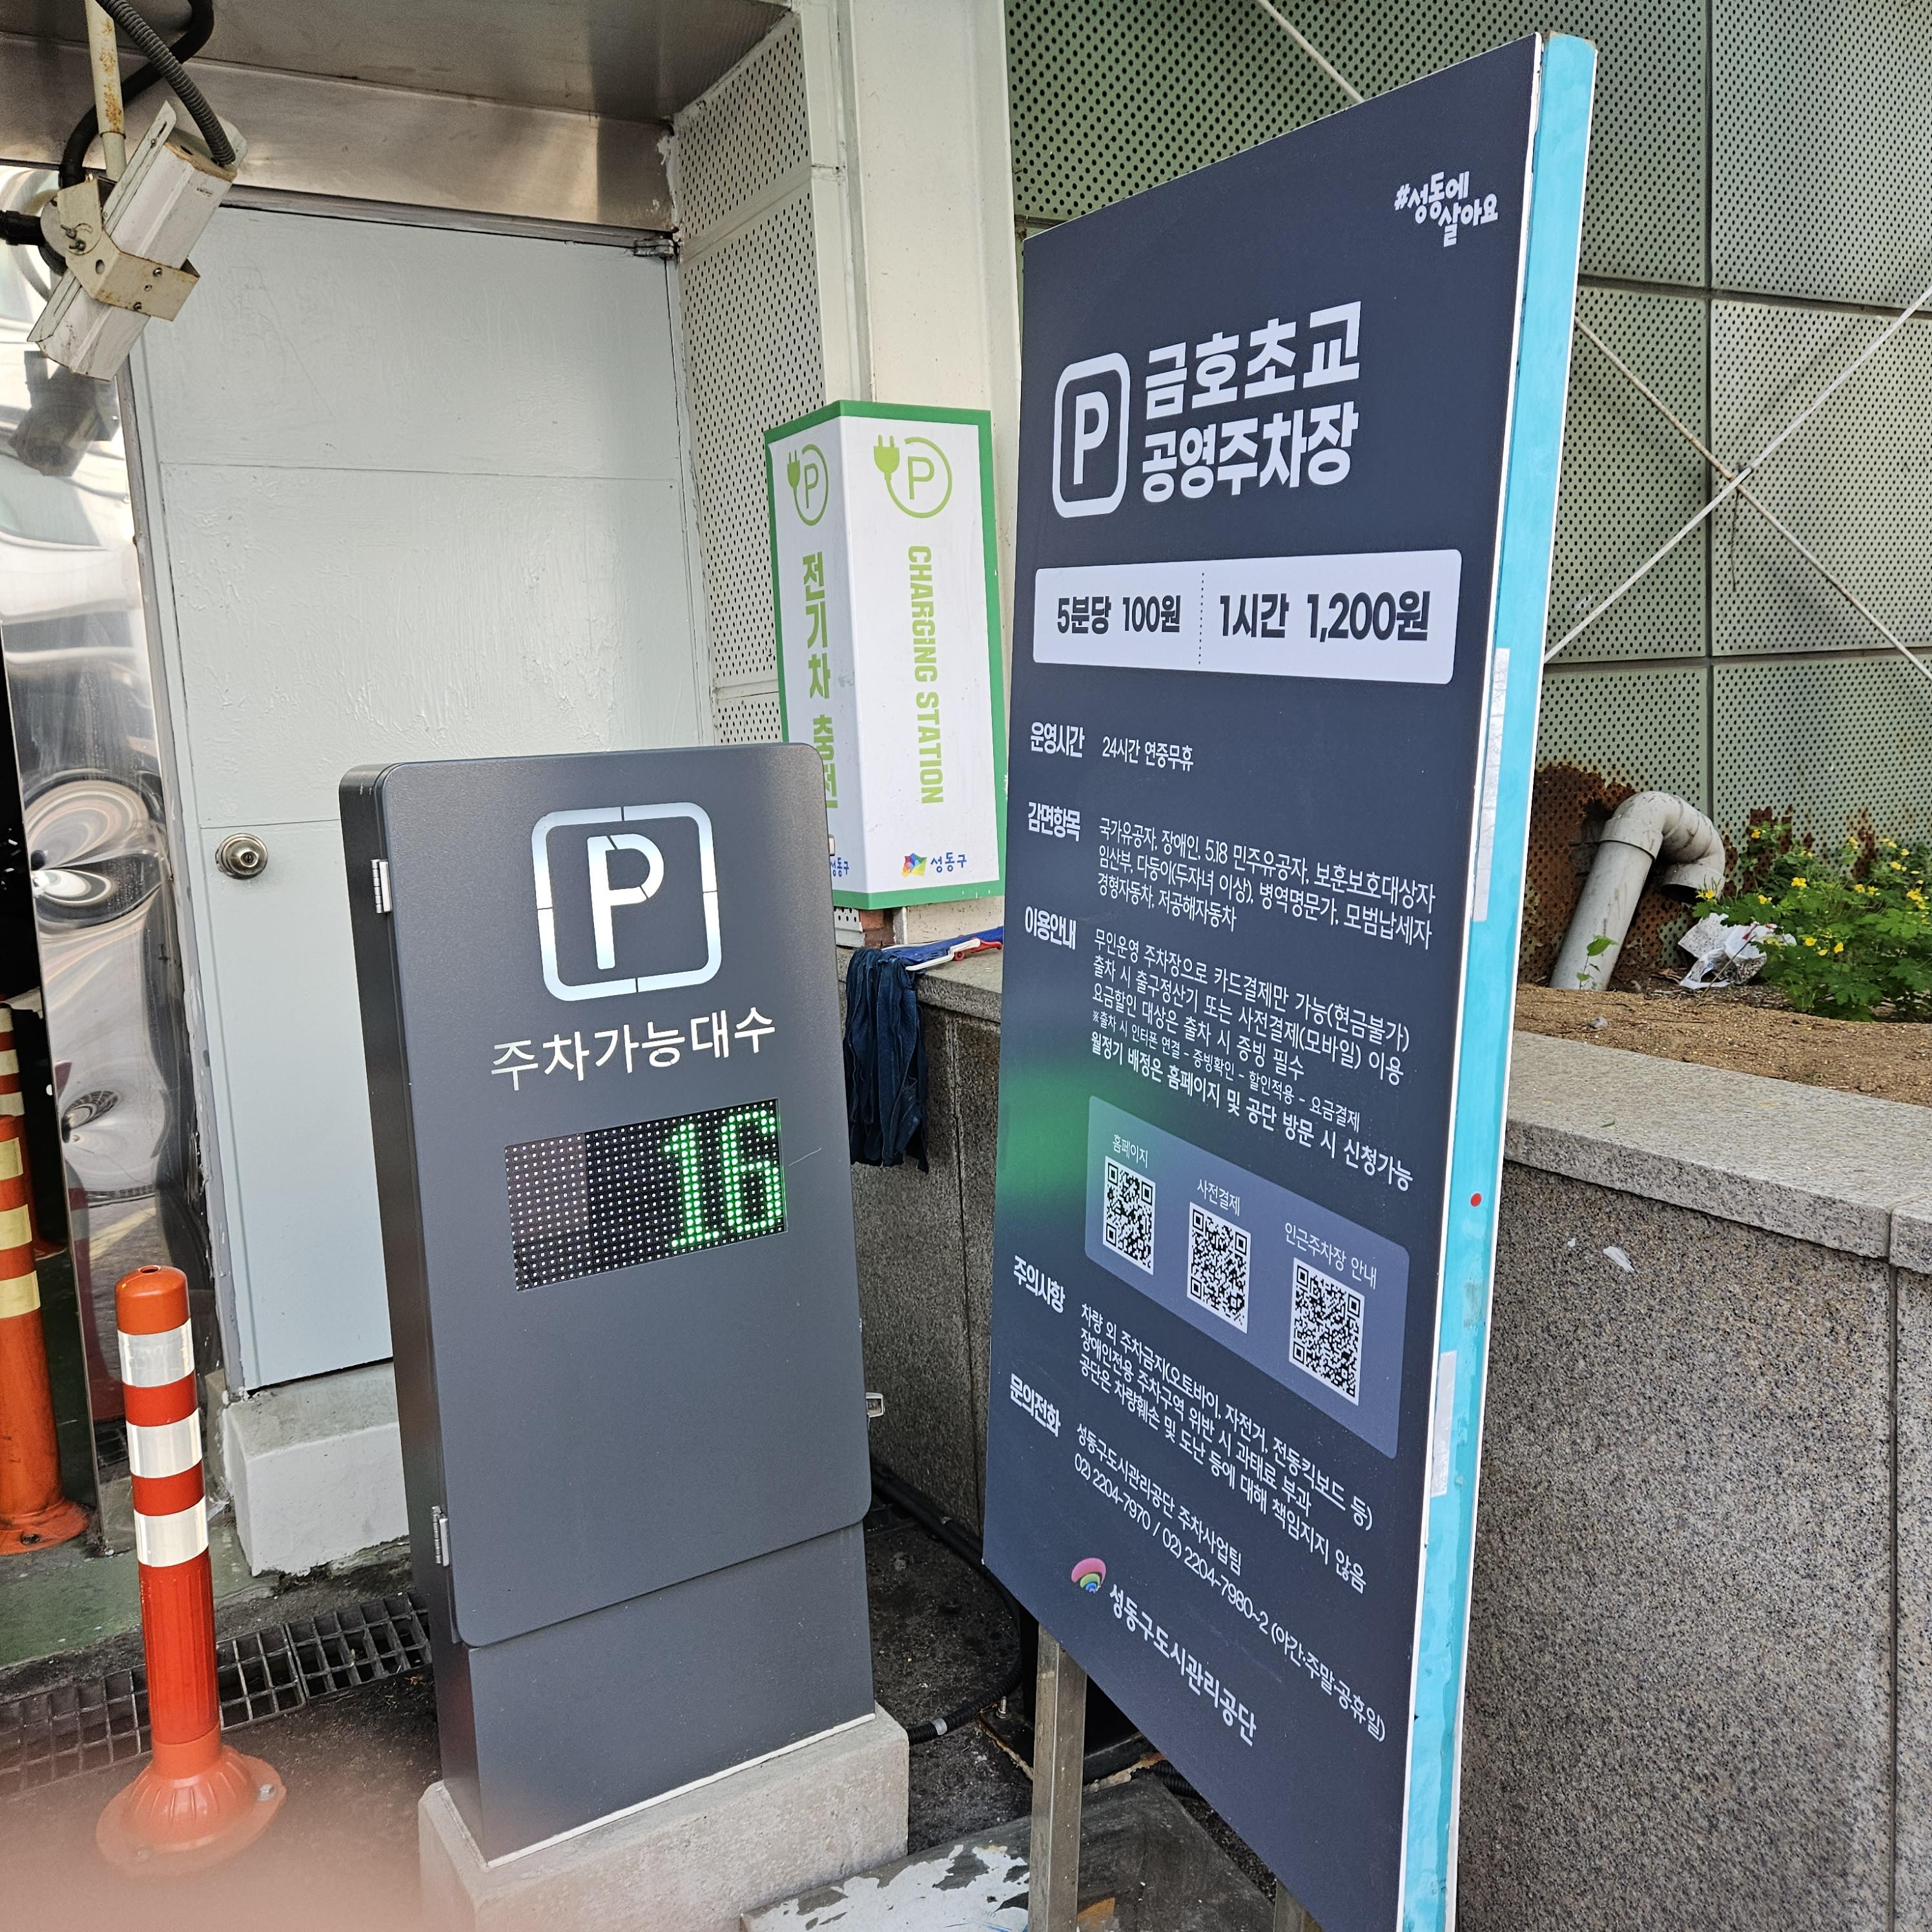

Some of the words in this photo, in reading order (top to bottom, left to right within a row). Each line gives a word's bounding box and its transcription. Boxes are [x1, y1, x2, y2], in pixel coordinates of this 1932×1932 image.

[1394, 171, 1470, 224] #성동에
[1438, 194, 1498, 247] 살아요
[1145, 301, 1361, 420] 금호초교
[805, 463, 819, 509] P
[908, 456, 935, 500] P
[1074, 391, 1109, 484] P
[1142, 402, 1359, 503] 공영주차장
[803, 551, 831, 699] 전기차
[908, 546, 938, 682] CHARGING
[1058, 595, 1111, 635] 5분당
[1122, 595, 1181, 633] 100원
[1220, 593, 1289, 638] 1시간
[1307, 590, 1430, 642] 1,200원
[916, 692, 944, 803] STATION
[1031, 722, 1085, 758] 운영시간
[1102, 736, 1141, 763] 24시간
[1145, 741, 1193, 772] 연중무휴
[930, 852, 967, 873] 성동구
[1028, 801, 1080, 842] 감면항목
[1099, 817, 1157, 851] 국가유공자,
[1162, 830, 1200, 860] 장애인,
[1205, 839, 1228, 864] 5.18
[1233, 845, 1310, 885] 민주유공자,
[1314, 862, 1436, 914] 보훈보호대상자
[586, 833, 664, 970] P
[1025, 906, 1076, 950] 이용안내
[1098, 872, 1155, 909] 경형자동차,
[1158, 889, 1237, 932] 저공해자동차
[1099, 845, 1133, 874] 임산부,
[1137, 855, 1214, 896] 다둥이(두자녀
[1219, 874, 1254, 904] 이상),
[1260, 882, 1339, 926] 병역명문가,
[1344, 903, 1432, 951] 모범납세자
[1093, 983, 1136, 1018] 요금할인
[1142, 1001, 1178, 1034] 대상은
[1184, 1016, 1211, 1047] 출차
[1217, 1030, 1230, 1055] 시
[1237, 1035, 1266, 1068] 증빙
[1273, 1048, 1304, 1081] 필수
[1094, 929, 1139, 963] 무인운영
[1144, 945, 1208, 984] 주차장으로
[1215, 967, 1289, 1012] 카드결제만
[1295, 992, 1410, 1052] 가능(현금불가)
[1094, 955, 1116, 982] 출차
[1120, 965, 1131, 989] 시
[1136, 970, 1198, 1013] 출구정산기
[1204, 995, 1233, 1024] 또는
[1238, 1006, 1361, 1069] 사전결제(모바일)
[1369, 1051, 1404, 1085] 이용
[490, 1006, 776, 1091] 주차가능대수
[1120, 1020, 1127, 1038] 시
[1131, 1024, 1158, 1050] 인터폰
[1162, 1036, 1180, 1059] 연결
[1193, 1049, 1234, 1082] 증빙확인
[1249, 1071, 1295, 1105] 할인적용
[1310, 1096, 1360, 1133] 요금결제
[1091, 1031, 1123, 1065] 월정기
[1128, 1047, 1164, 1082] 배정은
[1167, 1065, 1220, 1109] 홈페이지
[1227, 1089, 1240, 1117] 및
[1246, 1097, 1277, 1131] 공단
[1282, 1111, 1314, 1147] 방문
[1321, 1130, 1336, 1159] 시
[1344, 1138, 1413, 1191] 신청가능
[1112, 1134, 1149, 1169] 홈페이지
[663, 1108, 782, 1249] 16
[1197, 1178, 1240, 1217] 사전결제
[1013, 1255, 1065, 1313] 주의사항
[1284, 1221, 1346, 1271] 인근주차장
[1351, 1256, 1377, 1290] 안내
[1010, 1373, 1061, 1437] 문의전화
[1080, 1328, 1135, 1382] 장애인전용
[1136, 1370, 1184, 1422] 주차구역
[1189, 1407, 1215, 1443] 위반
[1218, 1430, 1231, 1457] 시
[1236, 1441, 1277, 1490] 과태료
[1281, 1475, 1312, 1517] 부과
[1081, 1303, 1103, 1334] 차량
[1105, 1321, 1116, 1346] 외
[1120, 1330, 1221, 1419] 주차금지(오토바이,
[1225, 1404, 1268, 1454] 자전거,
[1273, 1437, 1346, 1511] 전동킥보드
[1350, 1495, 1373, 1531] 등)
[1077, 1423, 1175, 1519] 성동구도시관리공단
[1178, 1505, 1241, 1576] 주차사업팀
[1079, 1353, 1112, 1393] 공단은
[1114, 1379, 1160, 1431] 차량훼손
[1164, 1415, 1176, 1444] 및
[1179, 1429, 1206, 1465] 도난
[1209, 1450, 1235, 1490] 등에
[1240, 1474, 1267, 1515] 대해
[1271, 1498, 1329, 1565] 책임지지
[1335, 1548, 1367, 1594] 않음
[1074, 1453, 1091, 1481] 02)
[1093, 1468, 1151, 1530] 2204-7970
[1153, 1521, 1160, 1536] /
[1162, 1528, 1182, 1558] 02)
[1184, 1546, 1269, 1635] 2204-7980~2
[1109, 1583, 1257, 1747] 성동구도시관리공단
